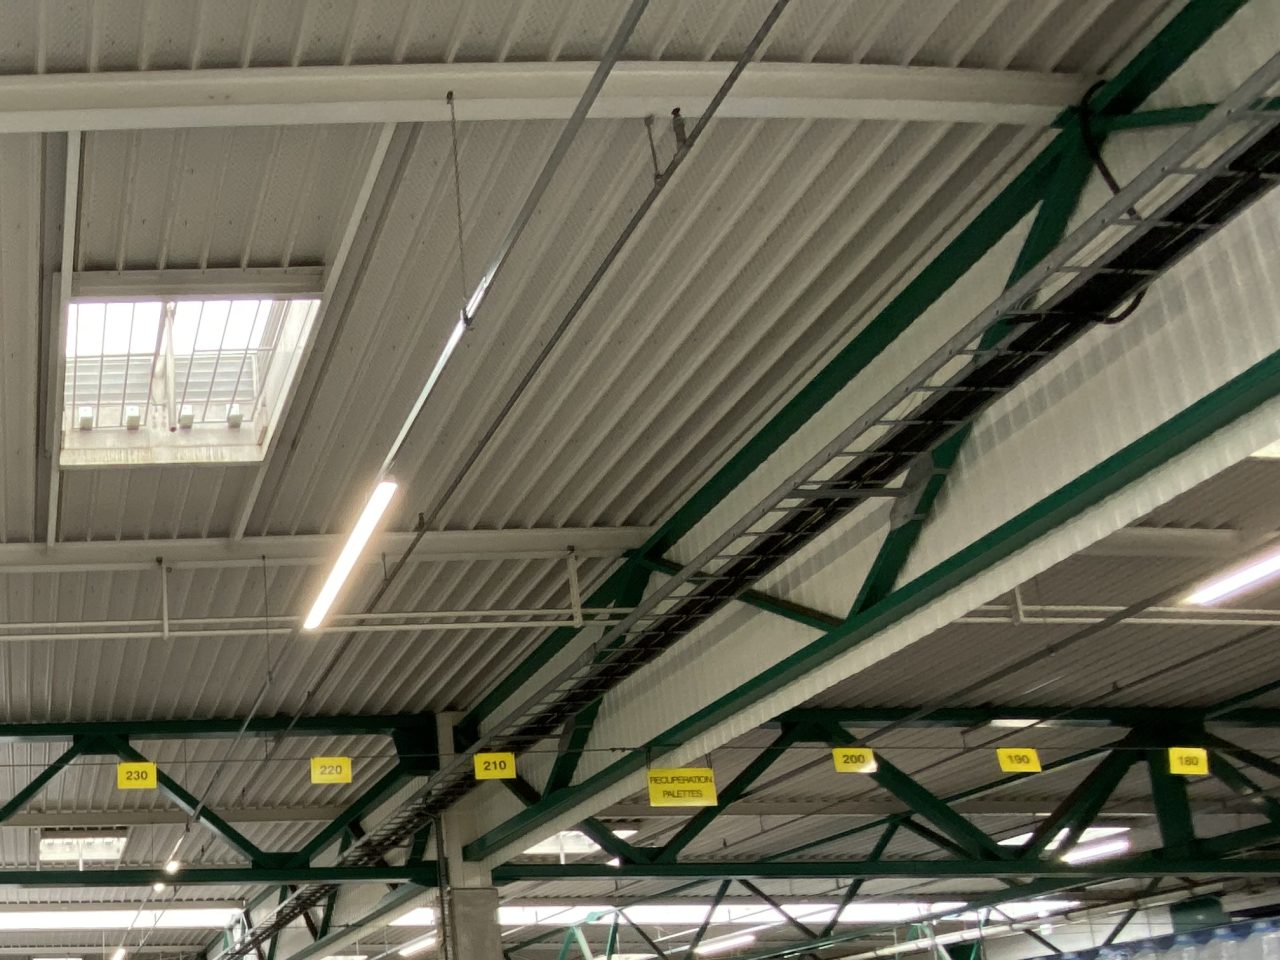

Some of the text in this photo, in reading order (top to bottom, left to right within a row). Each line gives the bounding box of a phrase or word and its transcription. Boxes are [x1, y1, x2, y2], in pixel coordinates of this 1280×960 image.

[842, 754, 865, 764] 200
[1007, 754, 1030, 765] 190
[320, 765, 342, 775] 220
[483, 760, 507, 771] 210
[126, 770, 148, 781] 230
[662, 789, 703, 799] PALETTES
